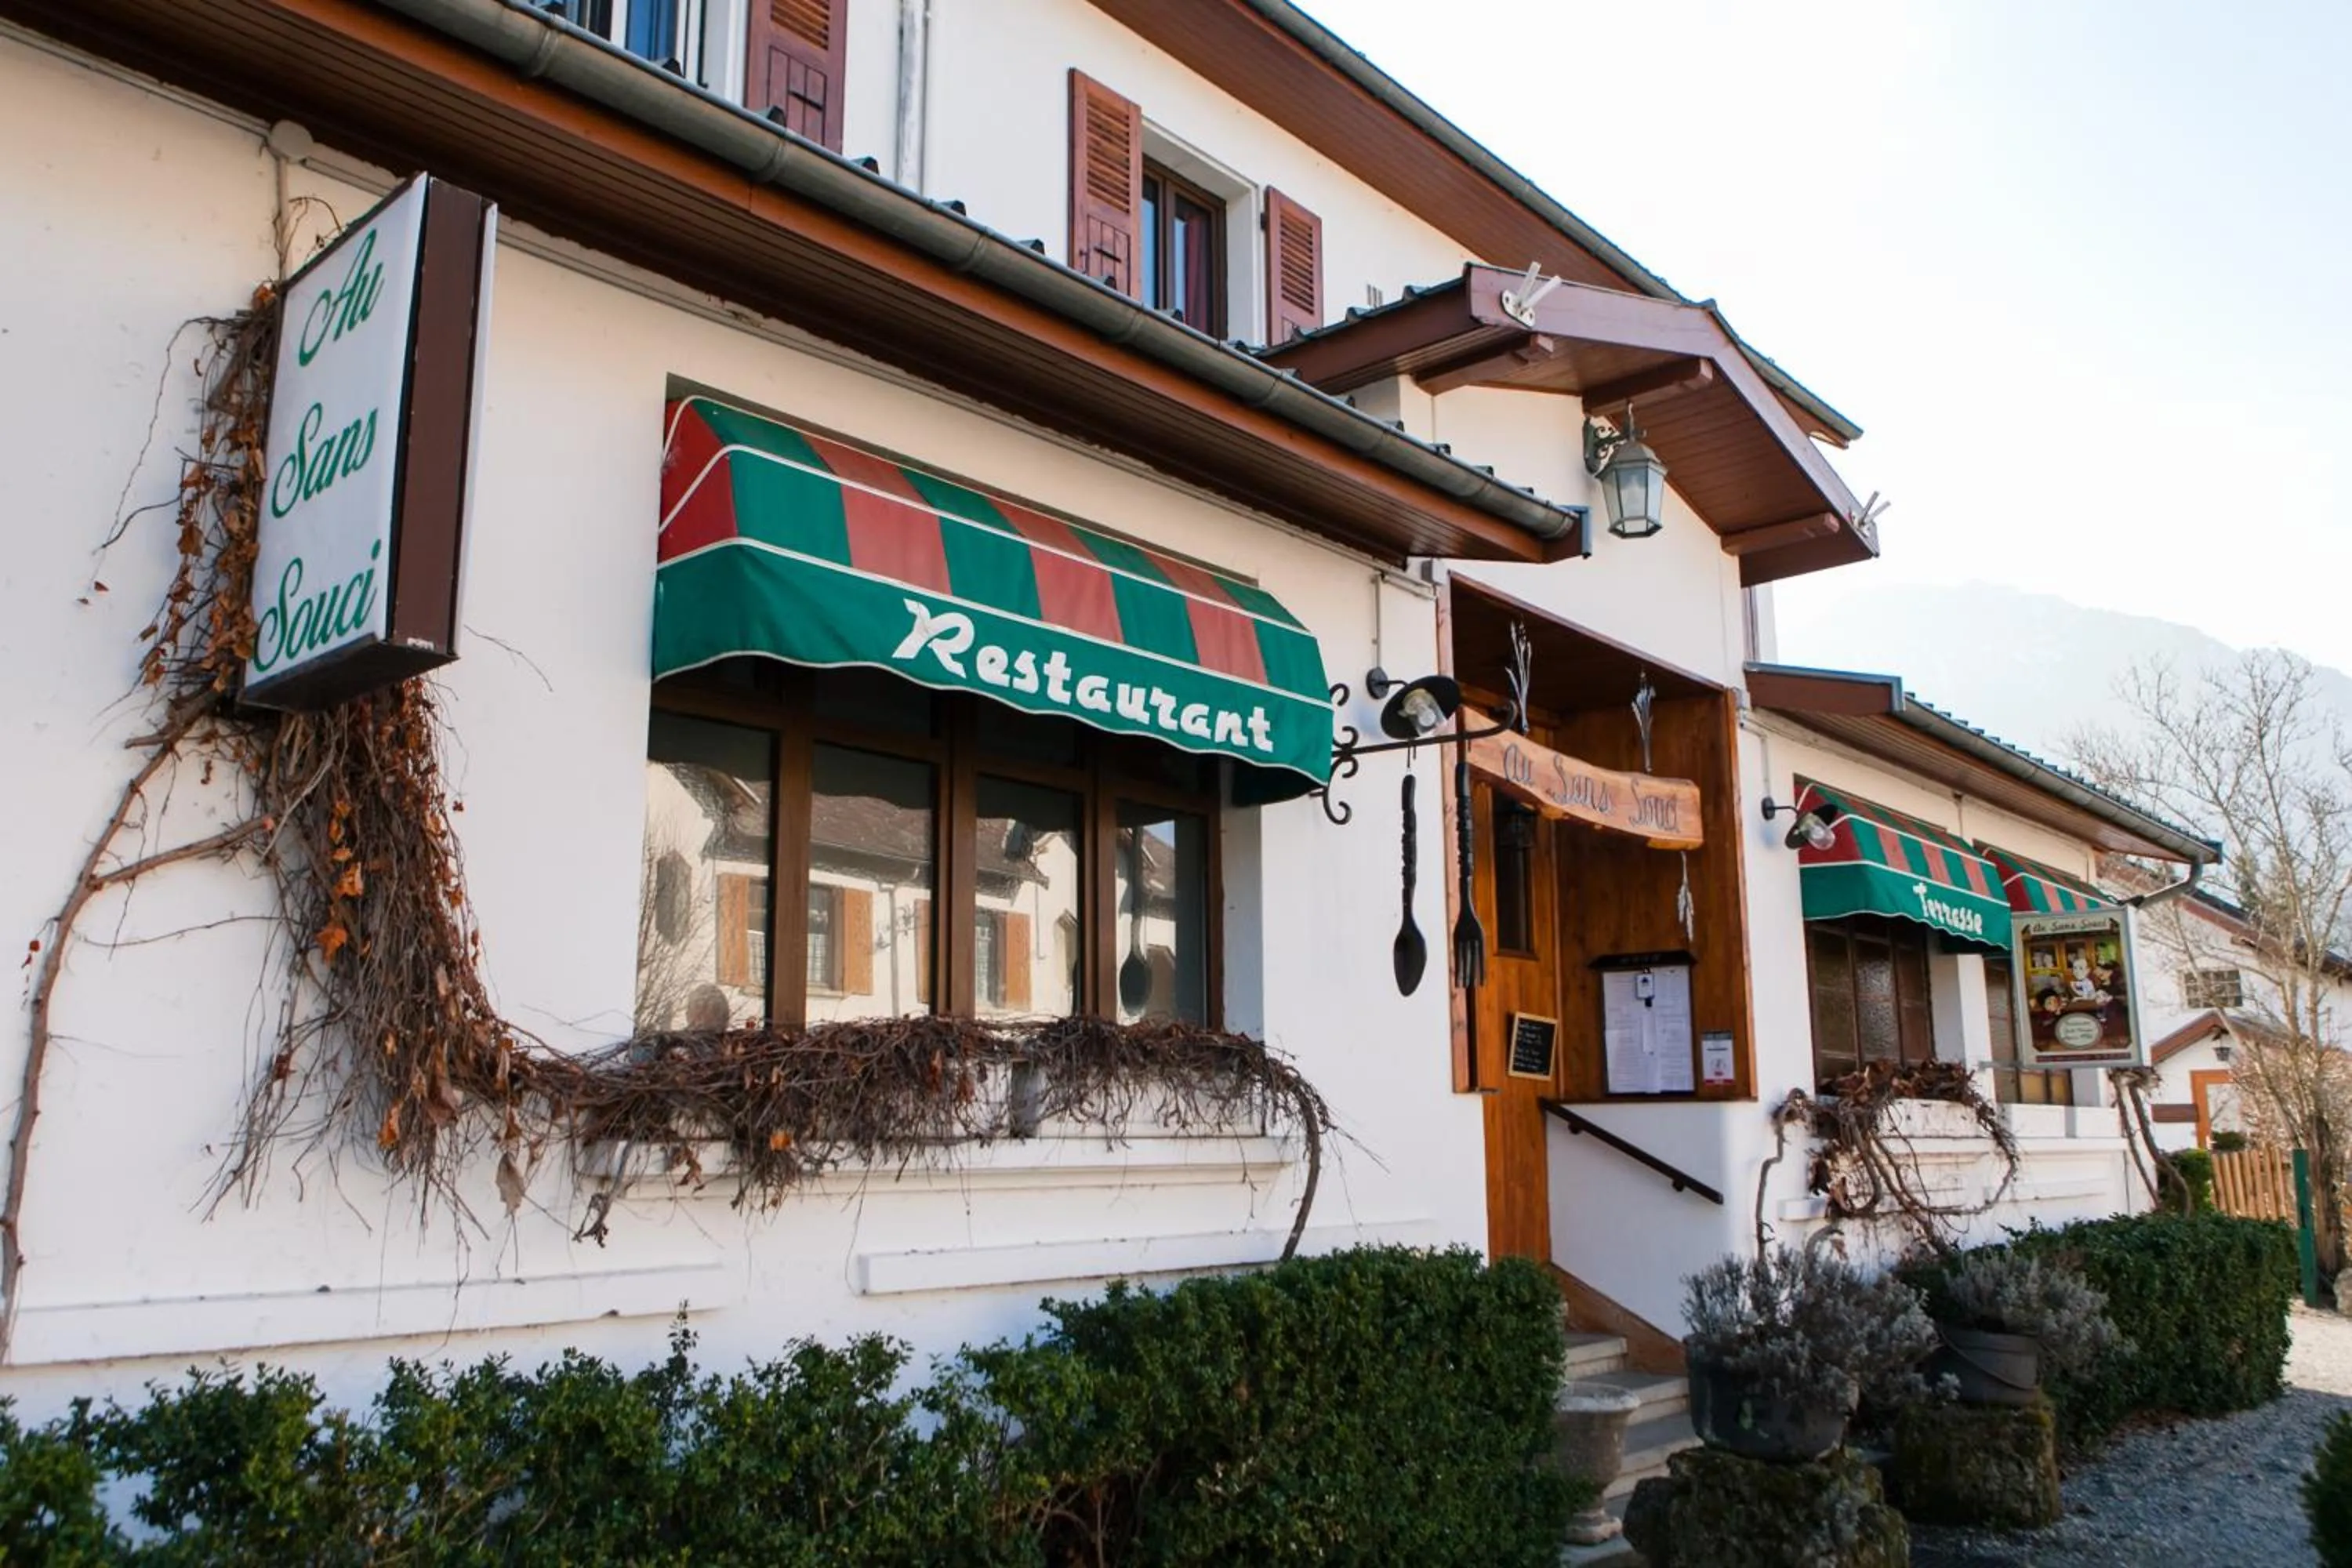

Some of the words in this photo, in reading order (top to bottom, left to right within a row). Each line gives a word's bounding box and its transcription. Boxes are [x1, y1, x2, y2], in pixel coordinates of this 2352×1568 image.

[298, 228, 385, 367] Au
[271, 402, 378, 518] Sans
[253, 539, 382, 672] Souci
[891, 598, 1273, 752] Restaurant
[1545, 754, 1613, 813] Sans
[1913, 882, 1982, 935] Terrasse
